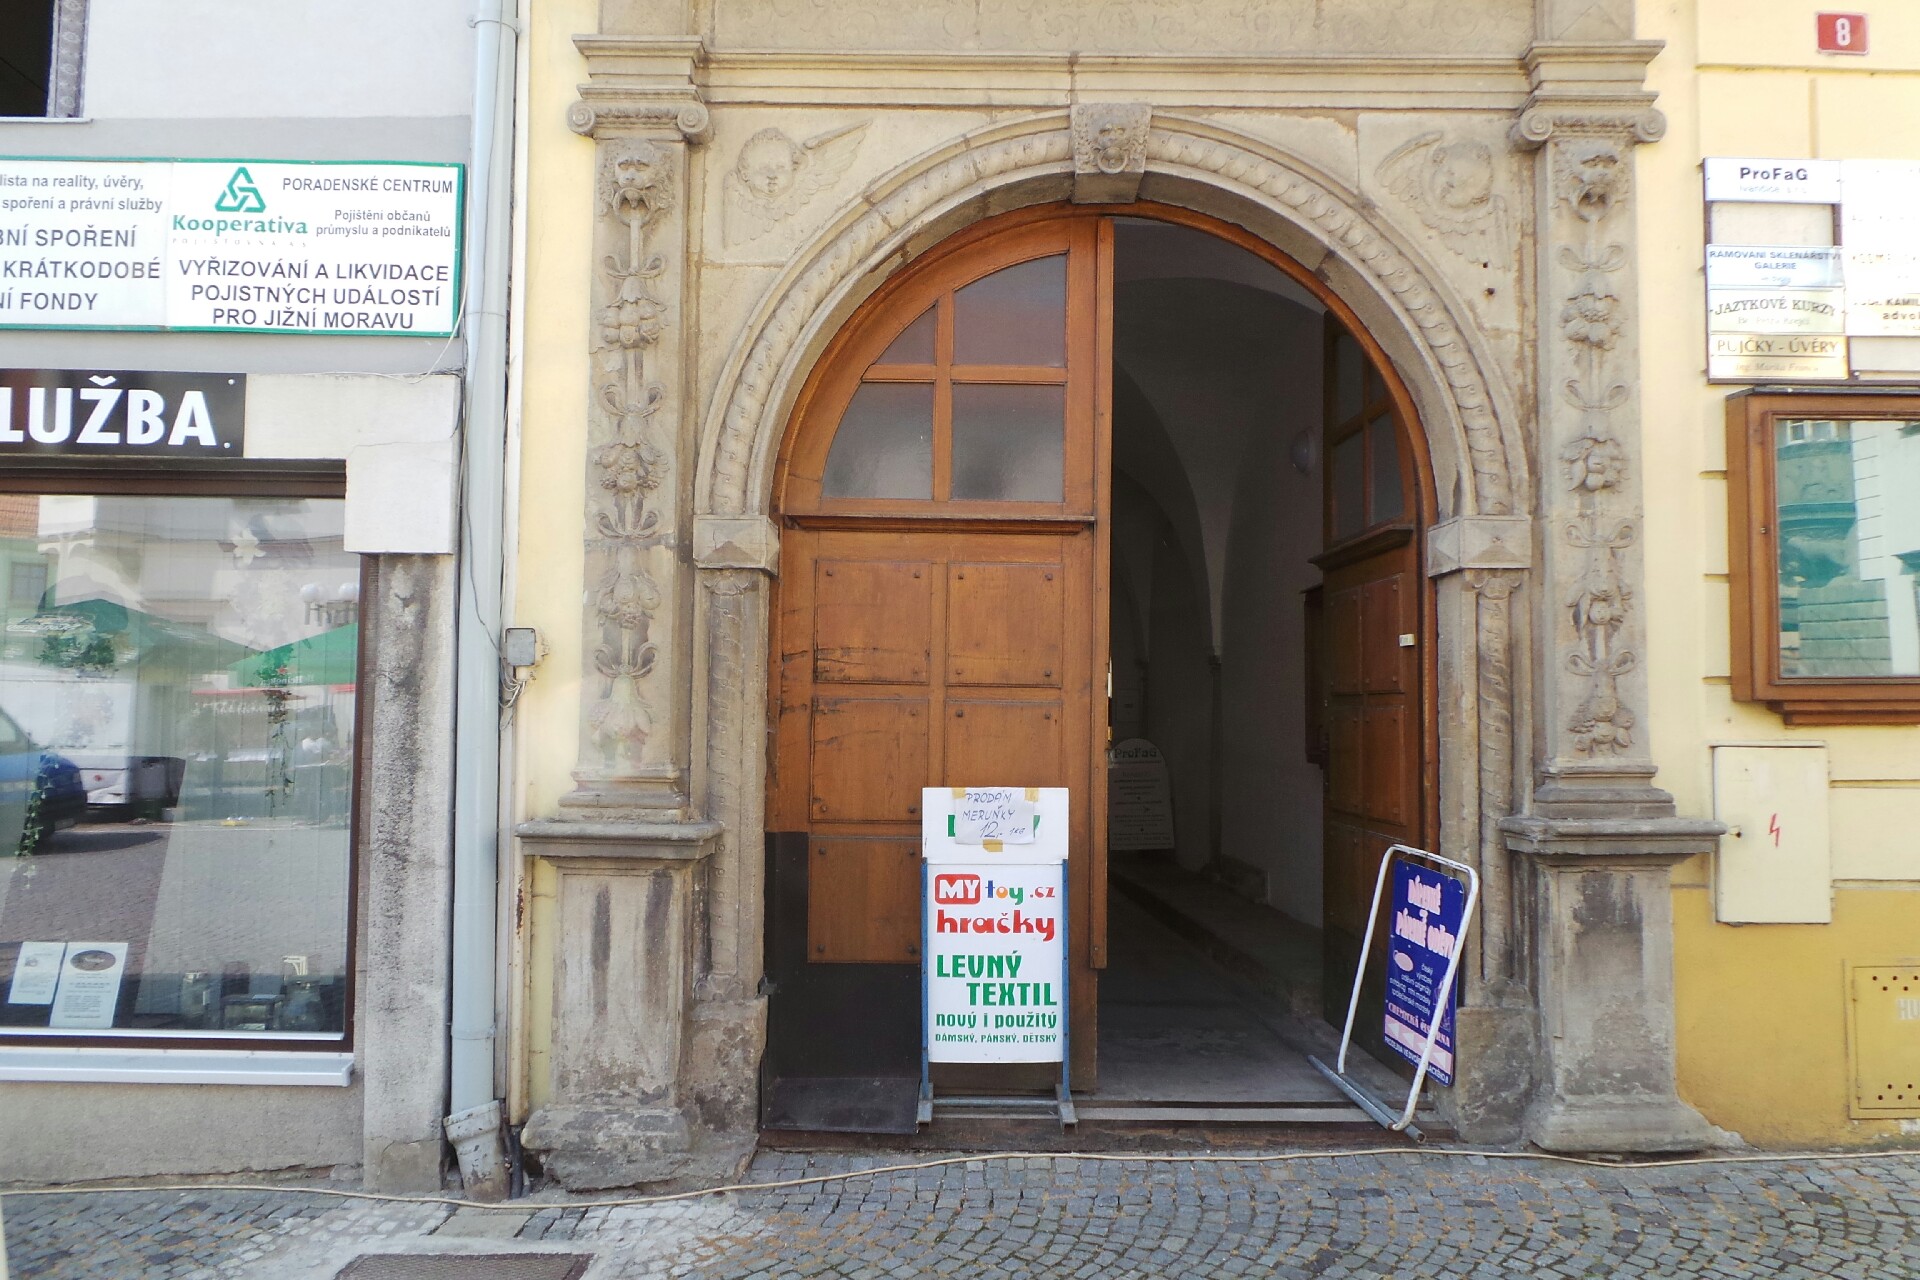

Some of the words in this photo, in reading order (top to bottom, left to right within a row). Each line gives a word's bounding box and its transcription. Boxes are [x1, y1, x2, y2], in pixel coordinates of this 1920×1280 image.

[1836, 18, 1851, 46] 8
[32, 178, 48, 187] na
[53, 175, 98, 190] reality,
[104, 175, 144, 190] úvěry,
[1740, 167, 1808, 180] ProFaG
[283, 175, 378, 192] PORADENSKÉ
[383, 179, 453, 194] CENTRUM
[2, 199, 54, 212] spoření
[58, 202, 66, 210] a
[71, 200, 114, 212] právní
[118, 198, 162, 213] služby
[173, 214, 308, 237] Kooperativa
[335, 209, 384, 223] Pojištění
[387, 209, 431, 222] občanů
[35, 224, 137, 247] SPOŘENÍ
[316, 224, 368, 238] průmyslu
[372, 227, 379, 235] a
[382, 225, 451, 238] podnikatelů
[4, 257, 160, 279] KRÁTKODOBÉ
[179, 255, 308, 279] VYŘIZOVÁNÍ
[315, 264, 329, 279] A
[336, 263, 449, 281] LIKVIDACE
[1755, 262, 1797, 270] GALERIE
[20, 292, 98, 310] FONDY
[192, 283, 326, 304] POJISTNÝCH
[334, 286, 440, 306] UDÁLOSTÍ
[1715, 296, 1788, 315] JAZYKOVÉ
[1792, 299, 1836, 317] KURZY
[213, 309, 257, 325] PRO
[264, 306, 316, 328] JIŽNÍ
[324, 312, 414, 329] MORAVU
[0, 374, 218, 446] LUŽBA
[965, 790, 1012, 804] PRODÁM
[962, 804, 1016, 821] MERUŇKY
[937, 909, 1055, 942] hračky
[937, 950, 1022, 978] LEVNÝ
[966, 982, 1057, 1006] TEXTIL
[935, 1011, 977, 1028] nový
[983, 1012, 988, 1027] i
[994, 1011, 1057, 1028] použitý
[935, 1033, 978, 1043] DÁMSKÝ,
[980, 1033, 1020, 1043] PÁNSKÝ,
[1022, 1032, 1057, 1043] DĚTSKÝ
